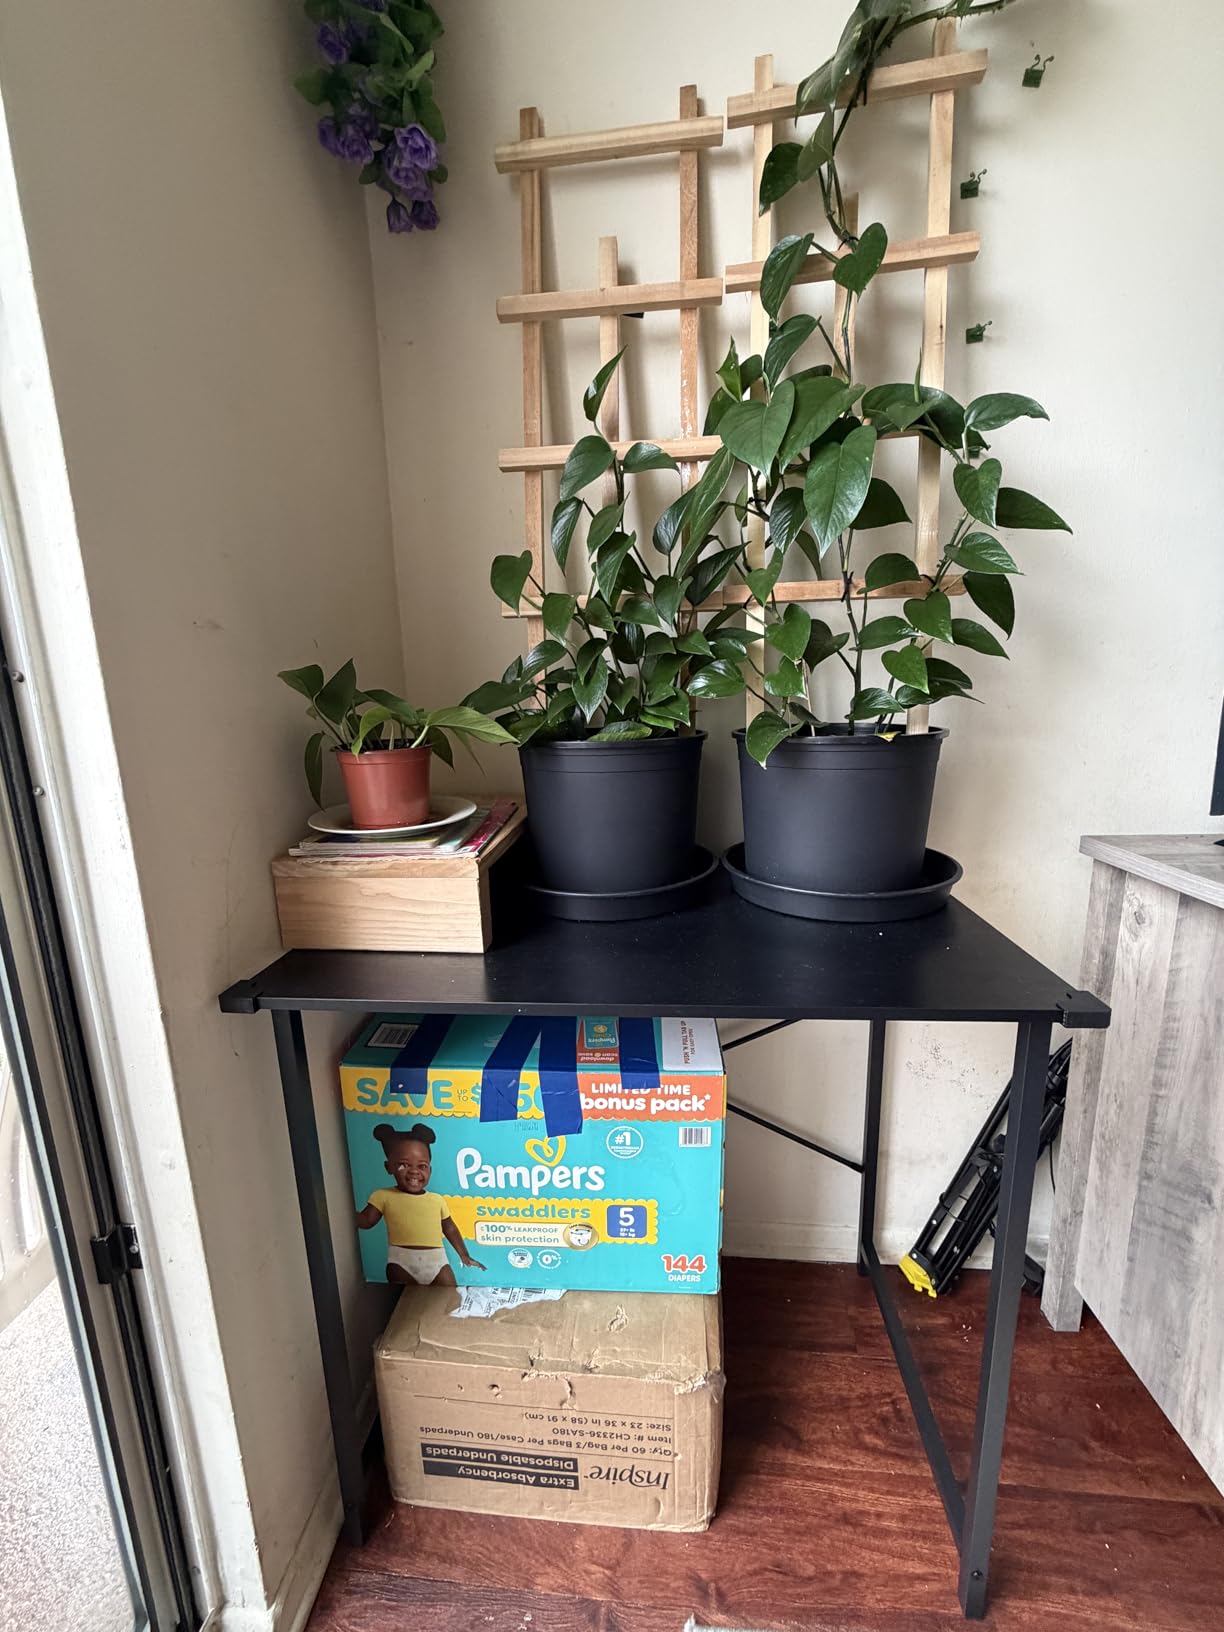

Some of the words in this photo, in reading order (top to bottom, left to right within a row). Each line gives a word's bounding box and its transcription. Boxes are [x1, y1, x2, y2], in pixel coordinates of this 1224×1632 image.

[580, 1093, 646, 1110] bonus
[615, 1132, 631, 1145] #1
[456, 1147, 605, 1196] Pampers
[476, 1205, 590, 1219] swaddlers
[619, 1207, 635, 1226] 5
[485, 1224, 512, 1233] 100%
[481, 1233, 502, 1242] skin
[504, 1236, 559, 1244] protection
[662, 1254, 706, 1273] 144
[524, 1412, 544, 1420] cm)
[571, 1417, 588, 1425] (58
[604, 1419, 617, 1427] 36
[420, 1426, 474, 1438] Underpads
[477, 1432, 524, 1443] Case/180
[552, 1428, 630, 1440] CH2336-SA180
[547, 1440, 572, 1448] Bags
[576, 1441, 608, 1450] Bag/3
[648, 1436, 671, 1444] Item
[611, 1444, 628, 1452] Per
[649, 1448, 672, 1456] Qty:
[425, 1446, 496, 1462] Underpads
[501, 1454, 574, 1470] Disposable
[458, 1465, 536, 1484] Absorbency
[540, 1476, 575, 1487] Extra
